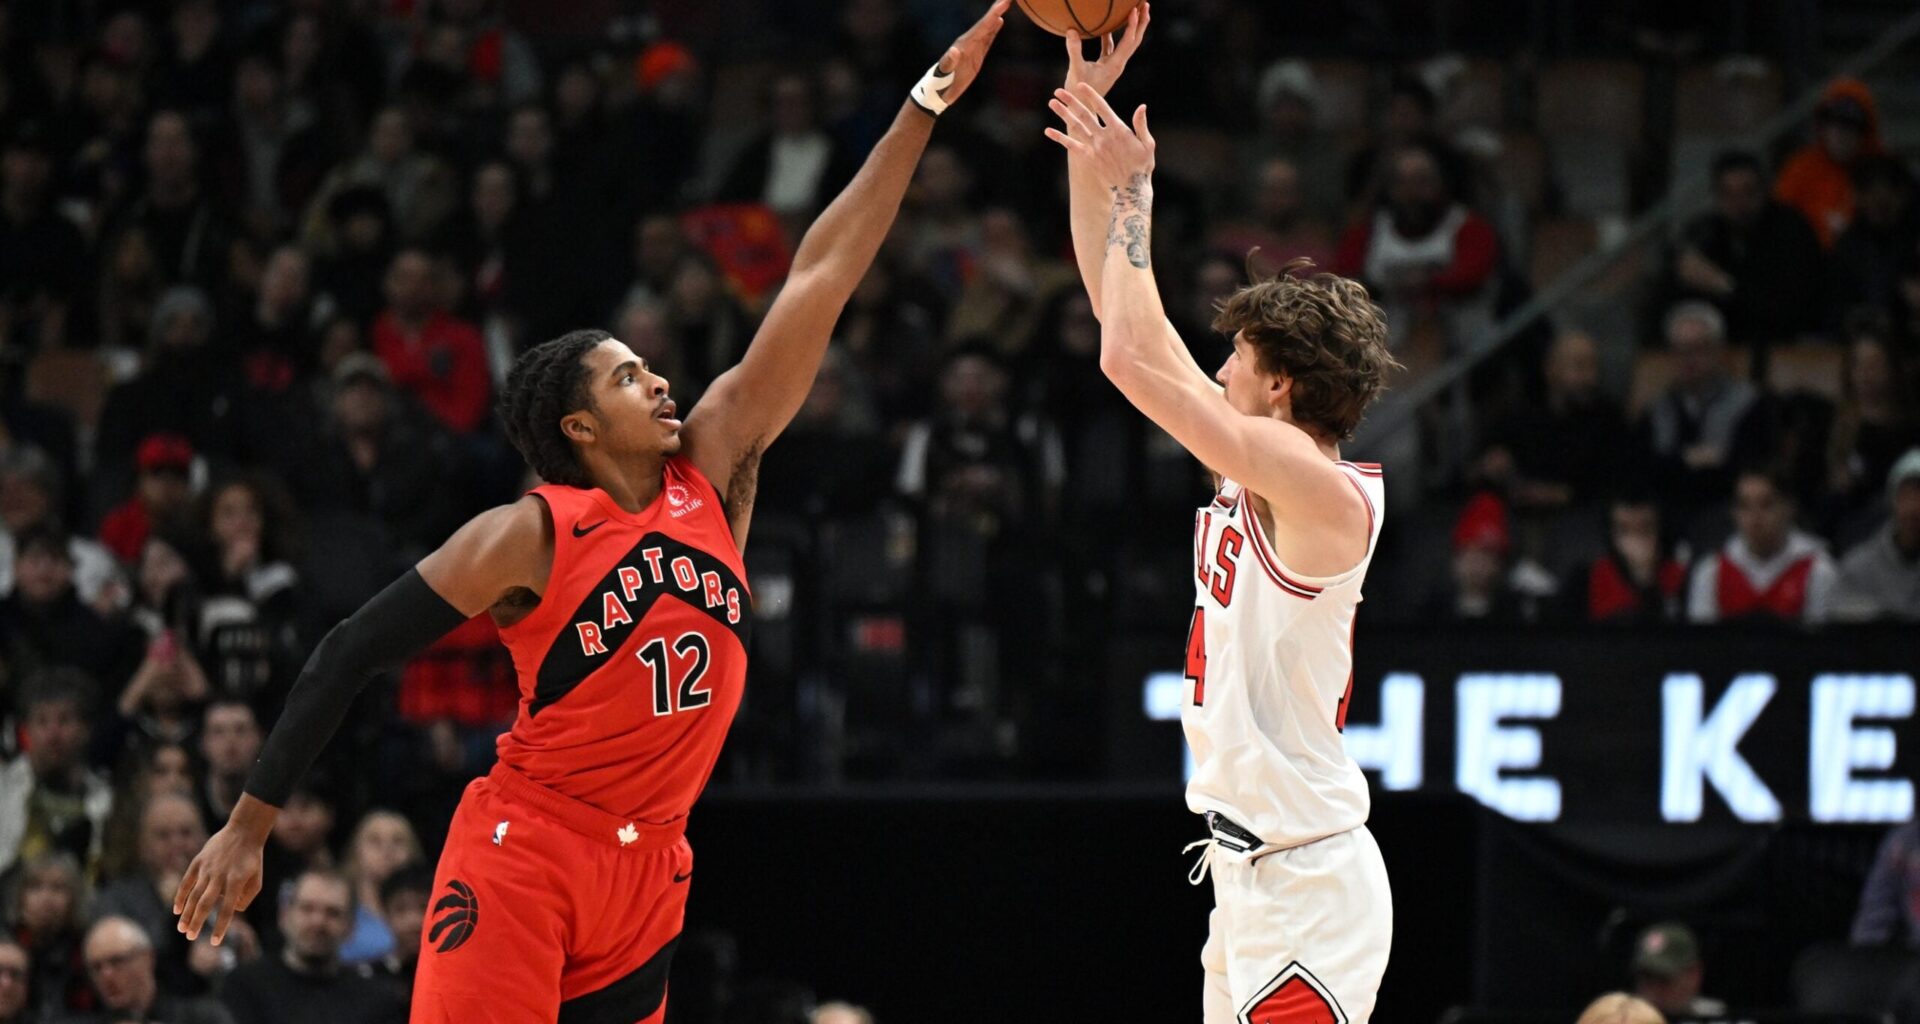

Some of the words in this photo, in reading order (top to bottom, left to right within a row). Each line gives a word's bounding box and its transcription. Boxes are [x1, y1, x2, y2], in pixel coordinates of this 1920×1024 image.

[685, 498, 704, 512] Life
[575, 547, 741, 656] RAPTORS
[636, 631, 712, 716] 12
[1660, 672, 1916, 823] KE
